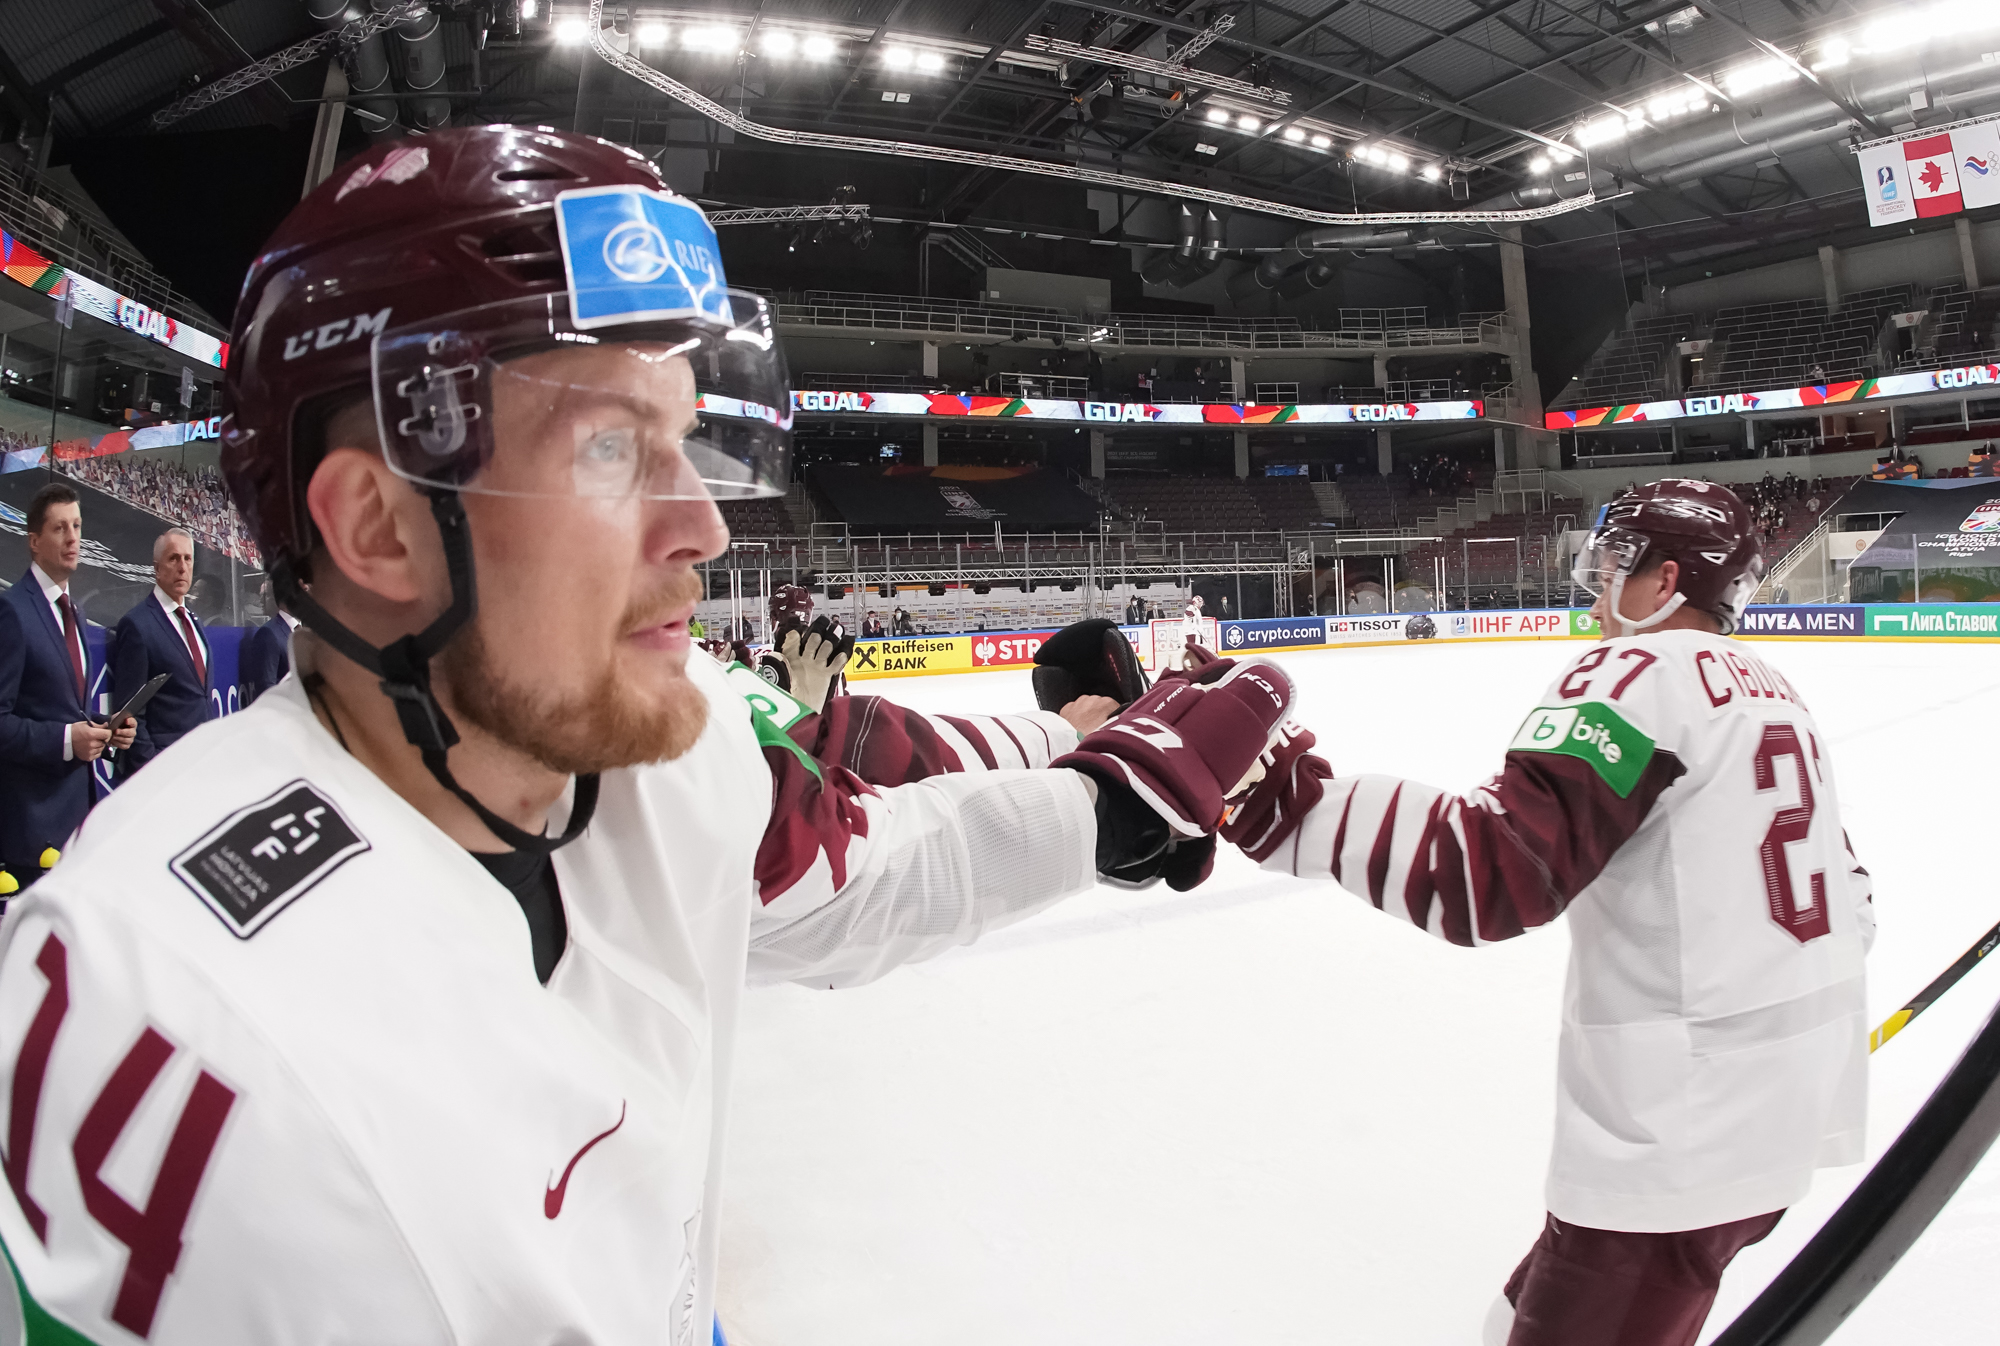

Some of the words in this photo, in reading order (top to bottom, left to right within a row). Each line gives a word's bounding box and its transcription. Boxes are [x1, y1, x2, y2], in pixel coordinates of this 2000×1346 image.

[118, 298, 171, 344] GOAL
[282, 307, 393, 361] CCM
[1938, 366, 1994, 389] GOAL
[802, 391, 866, 411] GOAL
[1084, 401, 1153, 422] GOAL
[1685, 393, 1752, 416] GOAL
[1356, 404, 1412, 421] GOAL
[1349, 620, 1401, 632] TISSOT
[1473, 616, 1513, 633] IIHF
[1519, 615, 1561, 632] APP
[1744, 613, 1802, 630] NIVEA
[1806, 613, 1854, 630] MEN
[1247, 626, 1321, 643] crypto.com
[882, 640, 954, 654] Raiffeisen
[999, 638, 1042, 660] STR
[884, 657, 927, 670] BANK
[1559, 646, 1658, 701] 27
[1238, 672, 1282, 709] CCM
[1571, 717, 1622, 764] bite
[1753, 724, 1831, 944] 2
[8, 932, 237, 1340] 14
